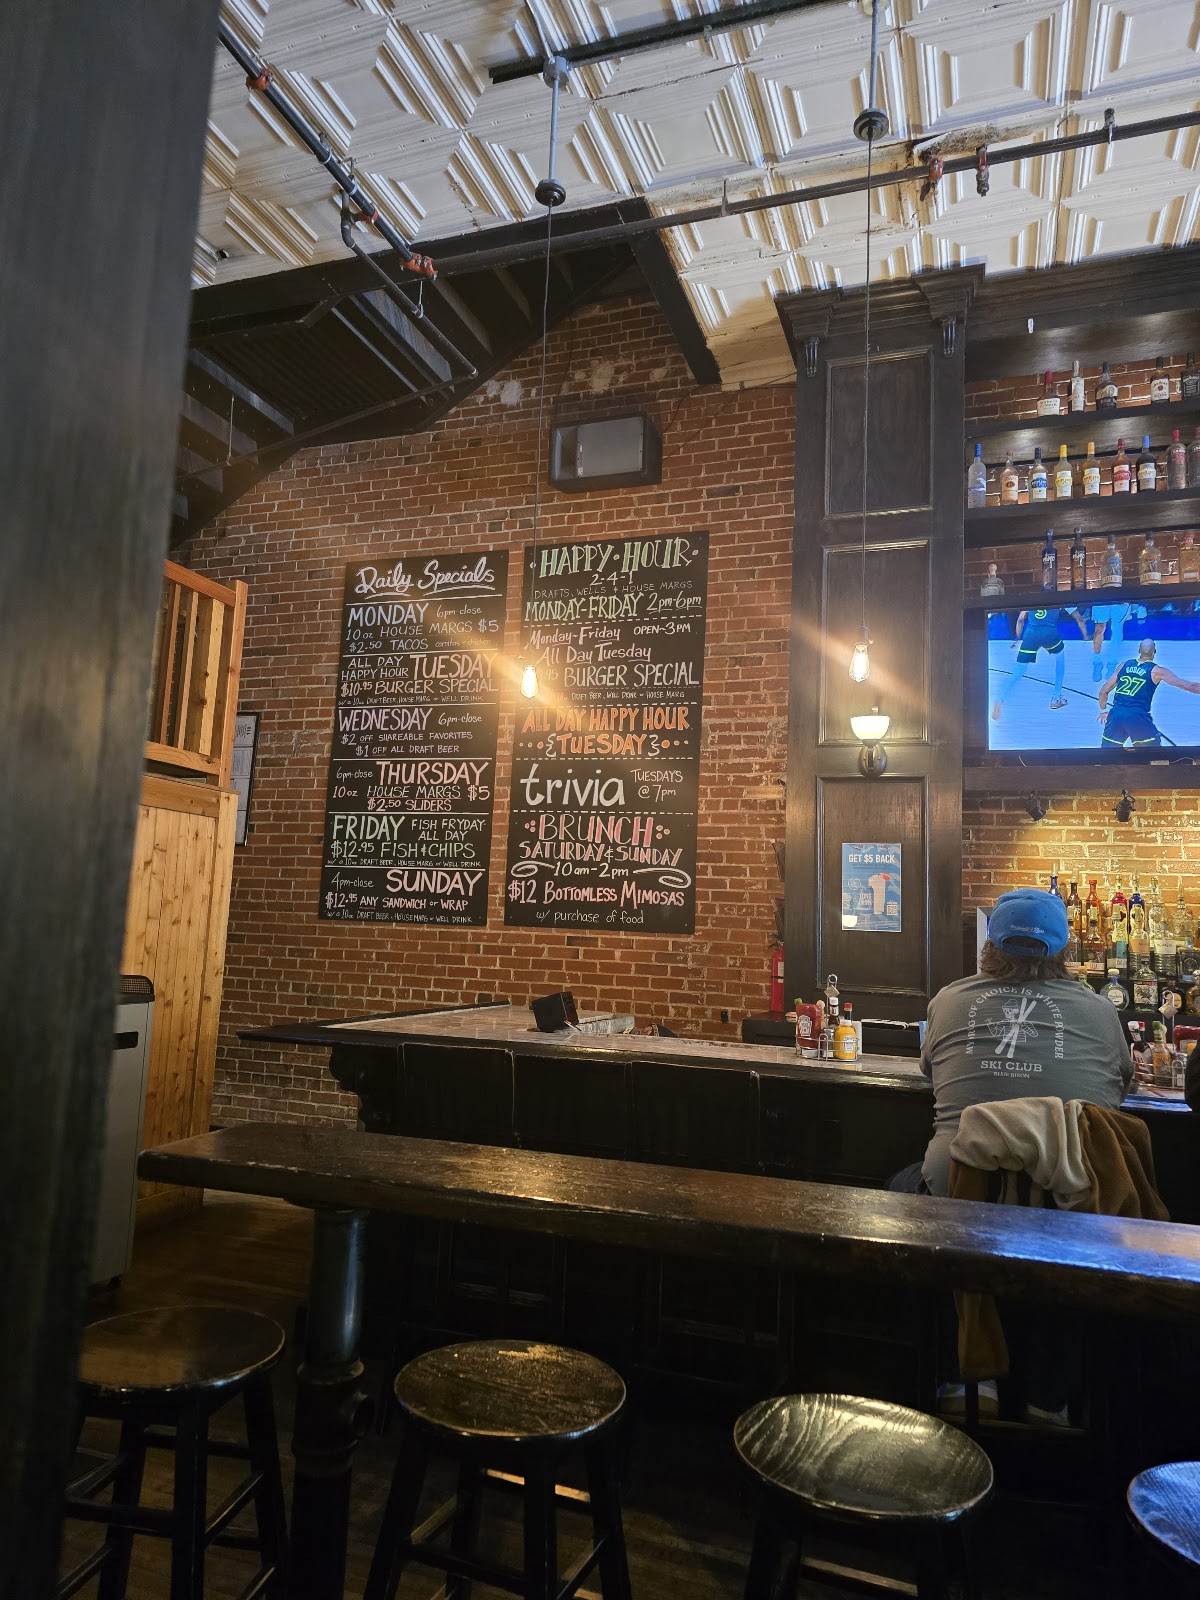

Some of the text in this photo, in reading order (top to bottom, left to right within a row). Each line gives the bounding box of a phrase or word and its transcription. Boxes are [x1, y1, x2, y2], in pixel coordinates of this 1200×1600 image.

[540, 537, 692, 578] HAPPY HOUR
[355, 556, 495, 593] Daily Specials
[590, 571, 634, 586] 2-4-1
[576, 586, 606, 596] WELLS
[622, 584, 655, 592] HOUSE
[660, 581, 692, 589] MARGS
[348, 603, 428, 627] MONDAY
[525, 591, 701, 622] MONDAY-FRIDAY 2pm-6pm
[380, 625, 422, 637] HOUSE
[428, 622, 472, 634] MARGS
[478, 619, 499, 632] $5
[349, 641, 382, 653] $2.50
[390, 639, 428, 651] TACOS
[536, 642, 651, 666] All Day Tuesday
[342, 668, 408, 681] HAPPY HOUR
[348, 653, 498, 680] ALL DAY TUESDAY
[564, 664, 626, 687] BURGER
[634, 662, 699, 687] SPECIAL
[341, 678, 498, 697] $10.95 BURGER SPECIAL
[572, 692, 586, 700] DRAFT
[1116, 676, 1146, 697] 27
[339, 708, 482, 732] WEDNESDAY 6pm-close
[522, 706, 690, 733] ALL DAY HAPPY HOUR
[341, 733, 356, 746] $2
[379, 732, 423, 742] SHAREABLE
[429, 732, 473, 740] FAVORITES
[356, 745, 369, 757] $1
[336, 761, 489, 786] 6pm-close THURSDAY
[367, 786, 410, 798] HOUSE
[416, 786, 461, 798] MARGS
[468, 785, 490, 801] $5
[520, 763, 683, 806] trivia TUESDAYS
[367, 799, 451, 812] $2.50 SLIDERS
[333, 815, 485, 841] FRIDAY FISH FRYDAY
[418, 831, 468, 841] ALL DAY
[539, 814, 653, 847] BRUNCH
[331, 840, 374, 859] $12.95
[519, 841, 604, 862] SATURDAY
[615, 847, 683, 866] SUNDAY
[848, 854, 895, 863] GET $5 BACK
[331, 869, 483, 896] 4pm-close SUNDAY
[508, 880, 536, 904] $12
[325, 892, 358, 909] $12.95
[360, 896, 378, 906] ANY
[382, 897, 426, 909] SANDWICH
[440, 900, 468, 911] WRAP
[357, 911, 374, 919] DRAFT
[394, 912, 413, 922] HOUSE
[536, 910, 643, 926] w/ purchase of food
[968, 1004, 977, 1018] OF
[976, 986, 1017, 1005] CHOICE
[1021, 988, 1033, 996] IS
[1036, 992, 1063, 1019] WHITE
[980, 1060, 1043, 1072] SKI CLUB
